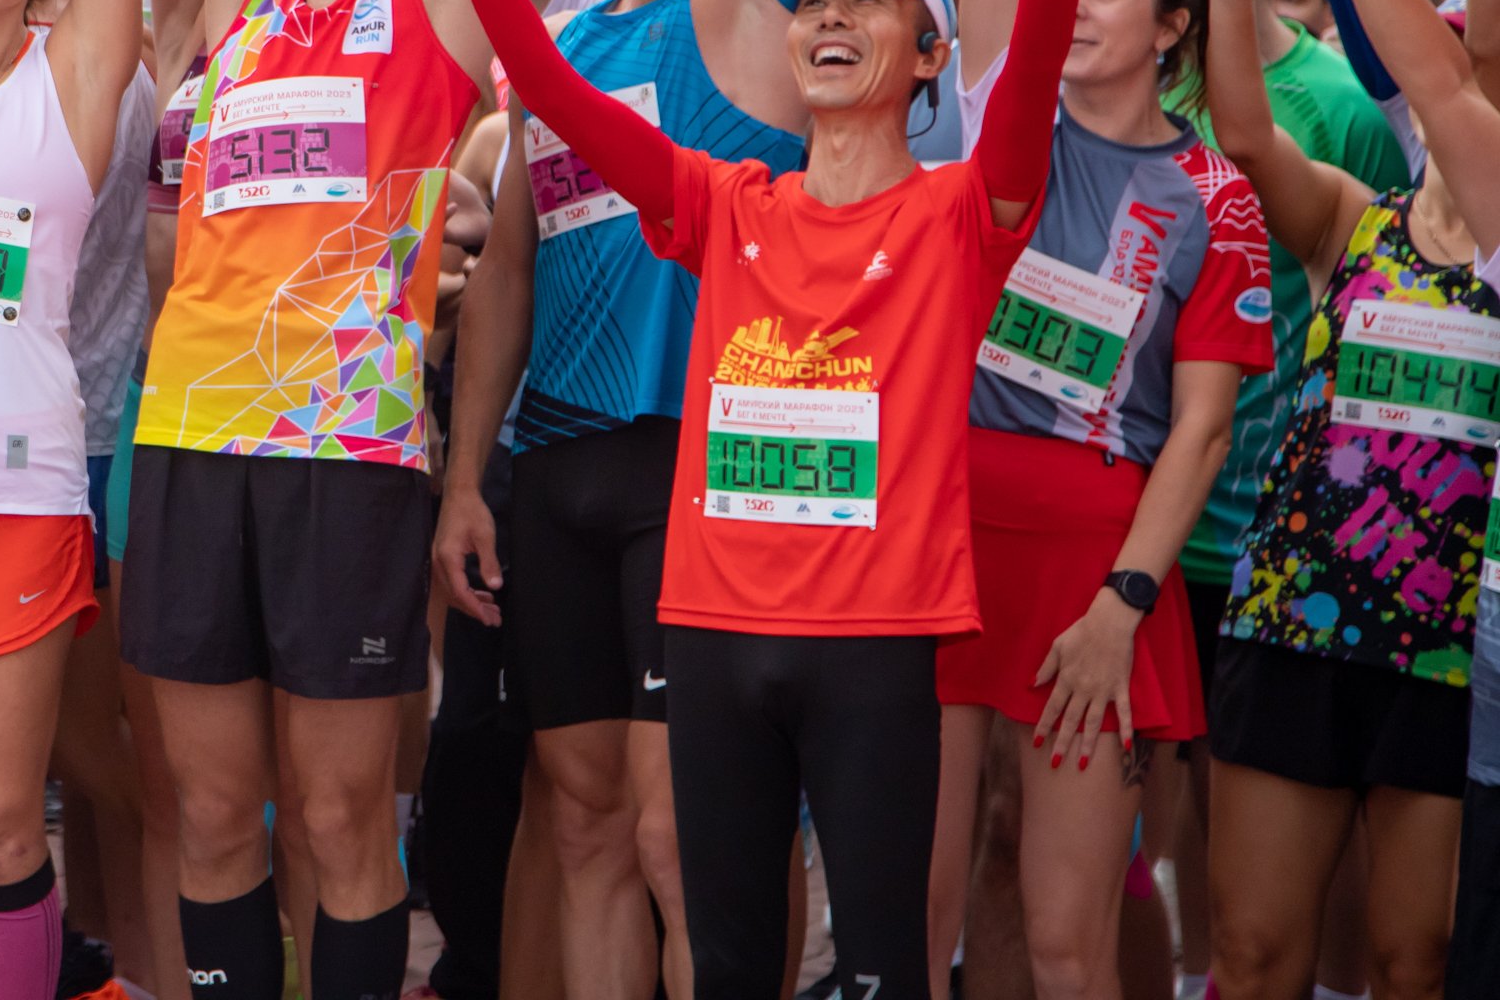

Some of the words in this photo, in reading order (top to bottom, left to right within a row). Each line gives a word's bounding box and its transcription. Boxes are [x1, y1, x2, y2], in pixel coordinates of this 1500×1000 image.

[351, 21, 386, 35] AMUR
[355, 32, 380, 45] RUN
[221, 104, 230, 122] V
[233, 93, 274, 109] АМУРСКИЙ
[277, 90, 323, 99] МАРАФОН
[231, 128, 329, 179] 5132
[1128, 201, 1178, 241] V
[1362, 312, 1377, 328] V
[723, 342, 874, 380] CHANGCHUN
[1355, 351, 1500, 415] 10444
[722, 398, 732, 416] V
[723, 440, 855, 492] 10058
